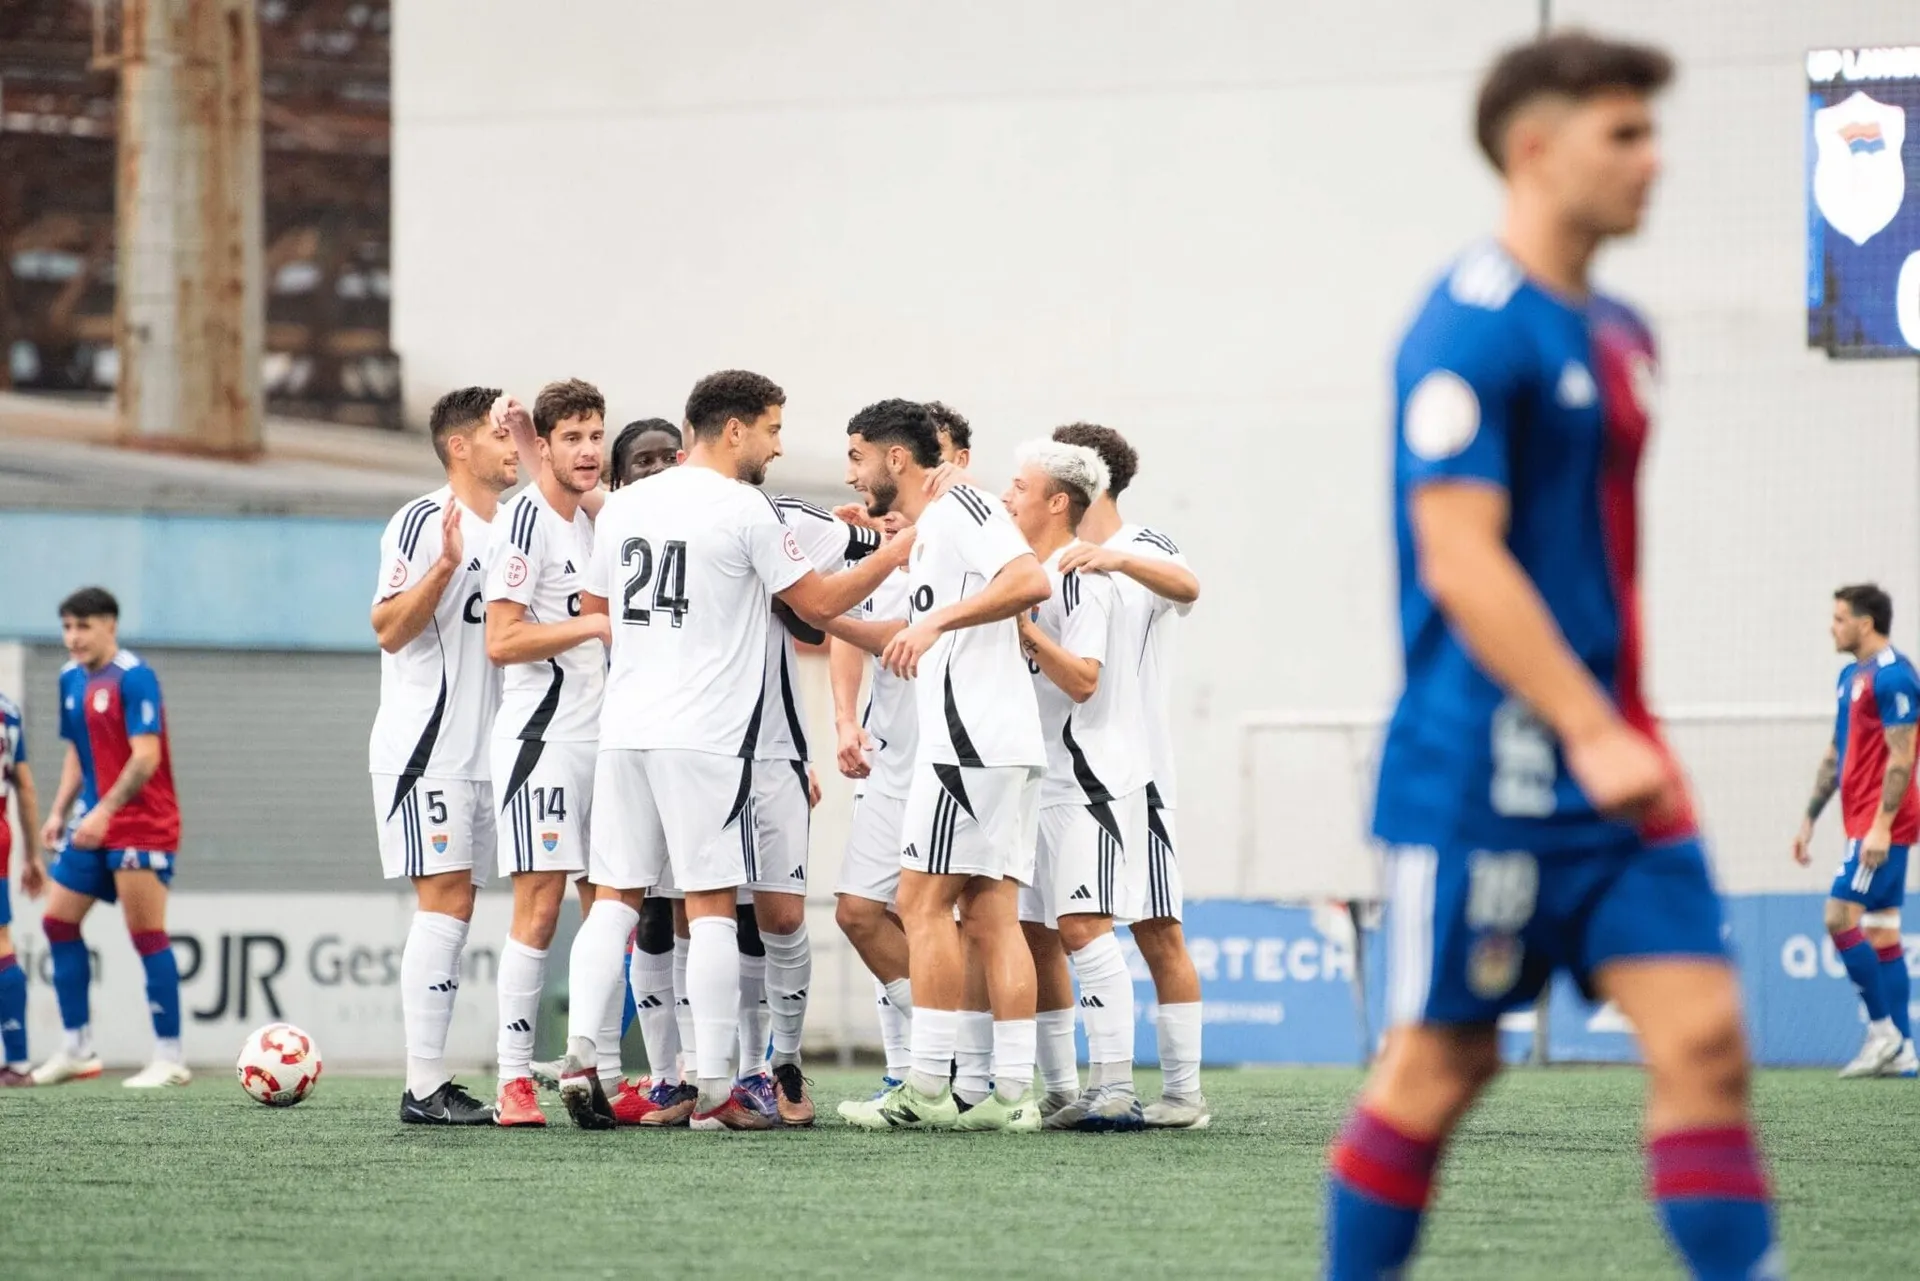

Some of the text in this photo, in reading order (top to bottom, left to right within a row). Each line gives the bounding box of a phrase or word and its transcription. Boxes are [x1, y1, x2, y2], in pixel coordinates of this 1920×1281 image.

[621, 537, 689, 628] 24
[425, 790, 448, 826] 5
[531, 787, 567, 823] 14
